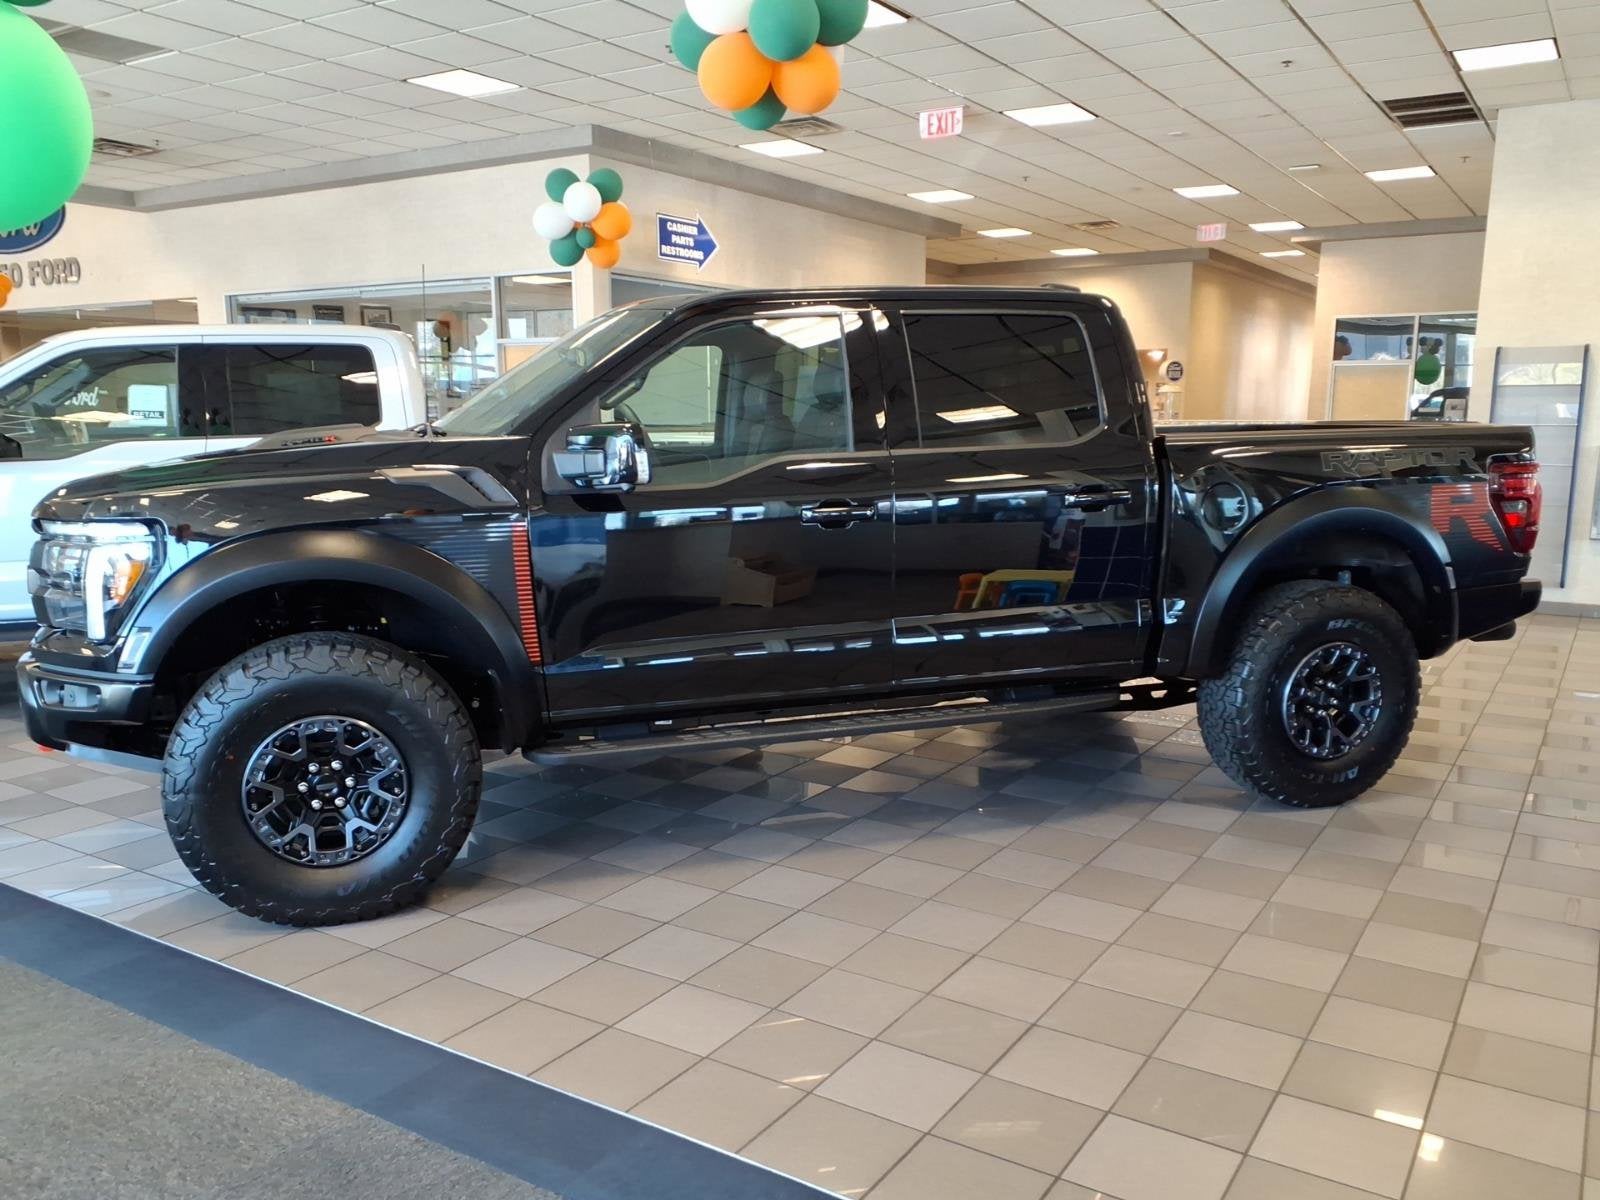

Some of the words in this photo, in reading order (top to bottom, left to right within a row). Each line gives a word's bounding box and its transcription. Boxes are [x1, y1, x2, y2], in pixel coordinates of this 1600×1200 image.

[927, 110, 957, 135] EXIT
[666, 221, 698, 236] CASHIER
[671, 234, 695, 247] PARTS
[661, 244, 705, 260] RESTROOMS
[28, 257, 81, 286] FORD
[1320, 446, 1484, 478] RAPTOR
[1430, 483, 1504, 551] R
